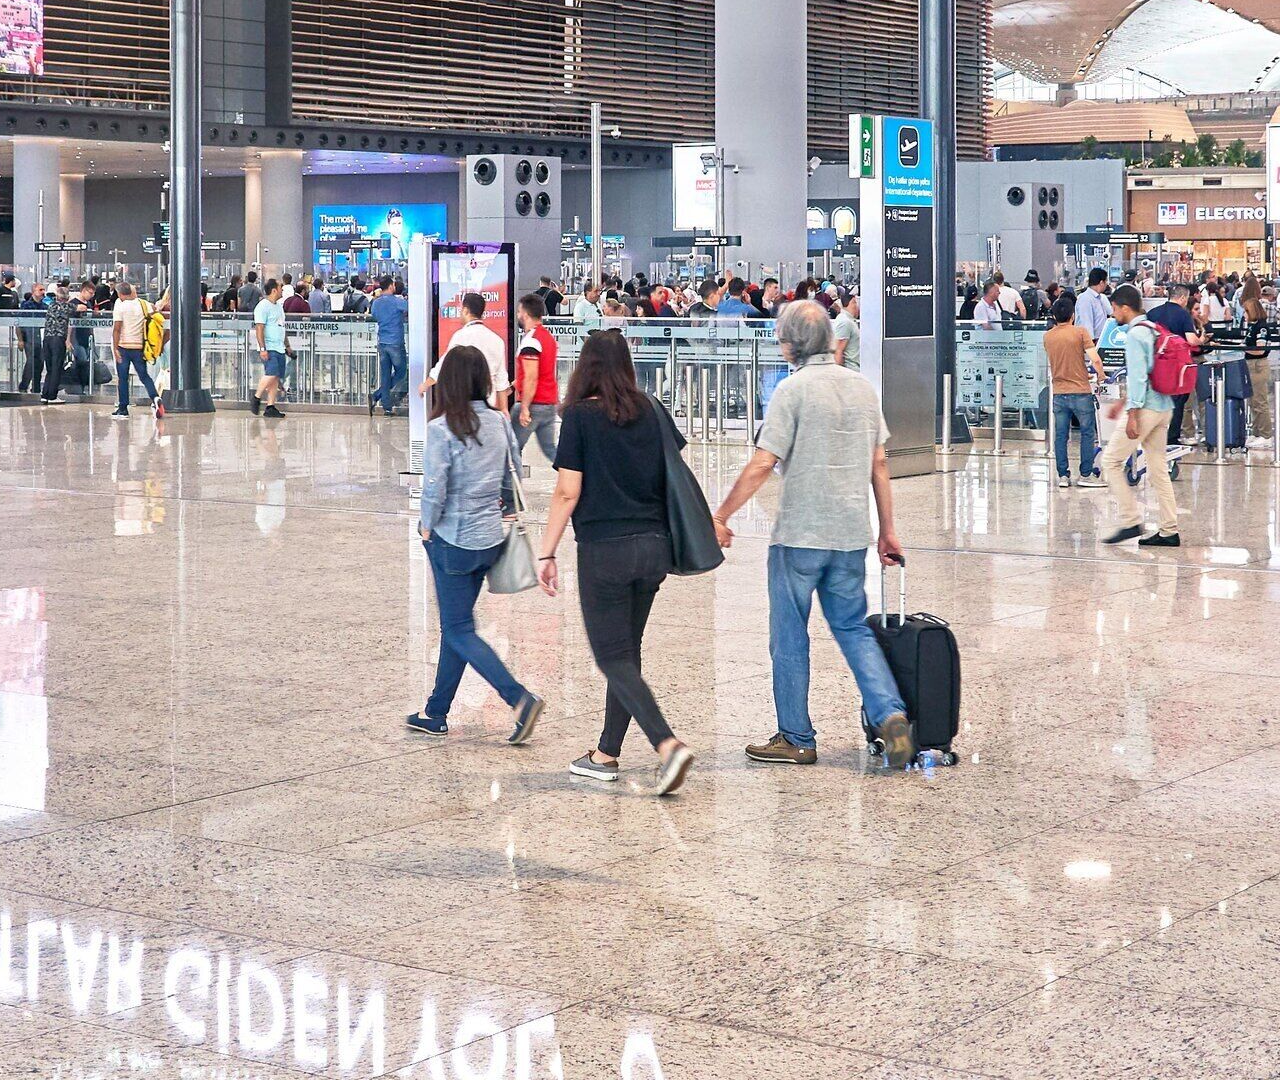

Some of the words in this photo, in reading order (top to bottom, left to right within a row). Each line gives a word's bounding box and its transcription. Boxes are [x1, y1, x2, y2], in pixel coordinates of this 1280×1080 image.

[1195, 207, 1266, 221] ELECTRO
[1139, 235, 1149, 243] 32
[299, 323, 339, 331] DEPARTURES
[555, 327, 578, 335] YOLCU
